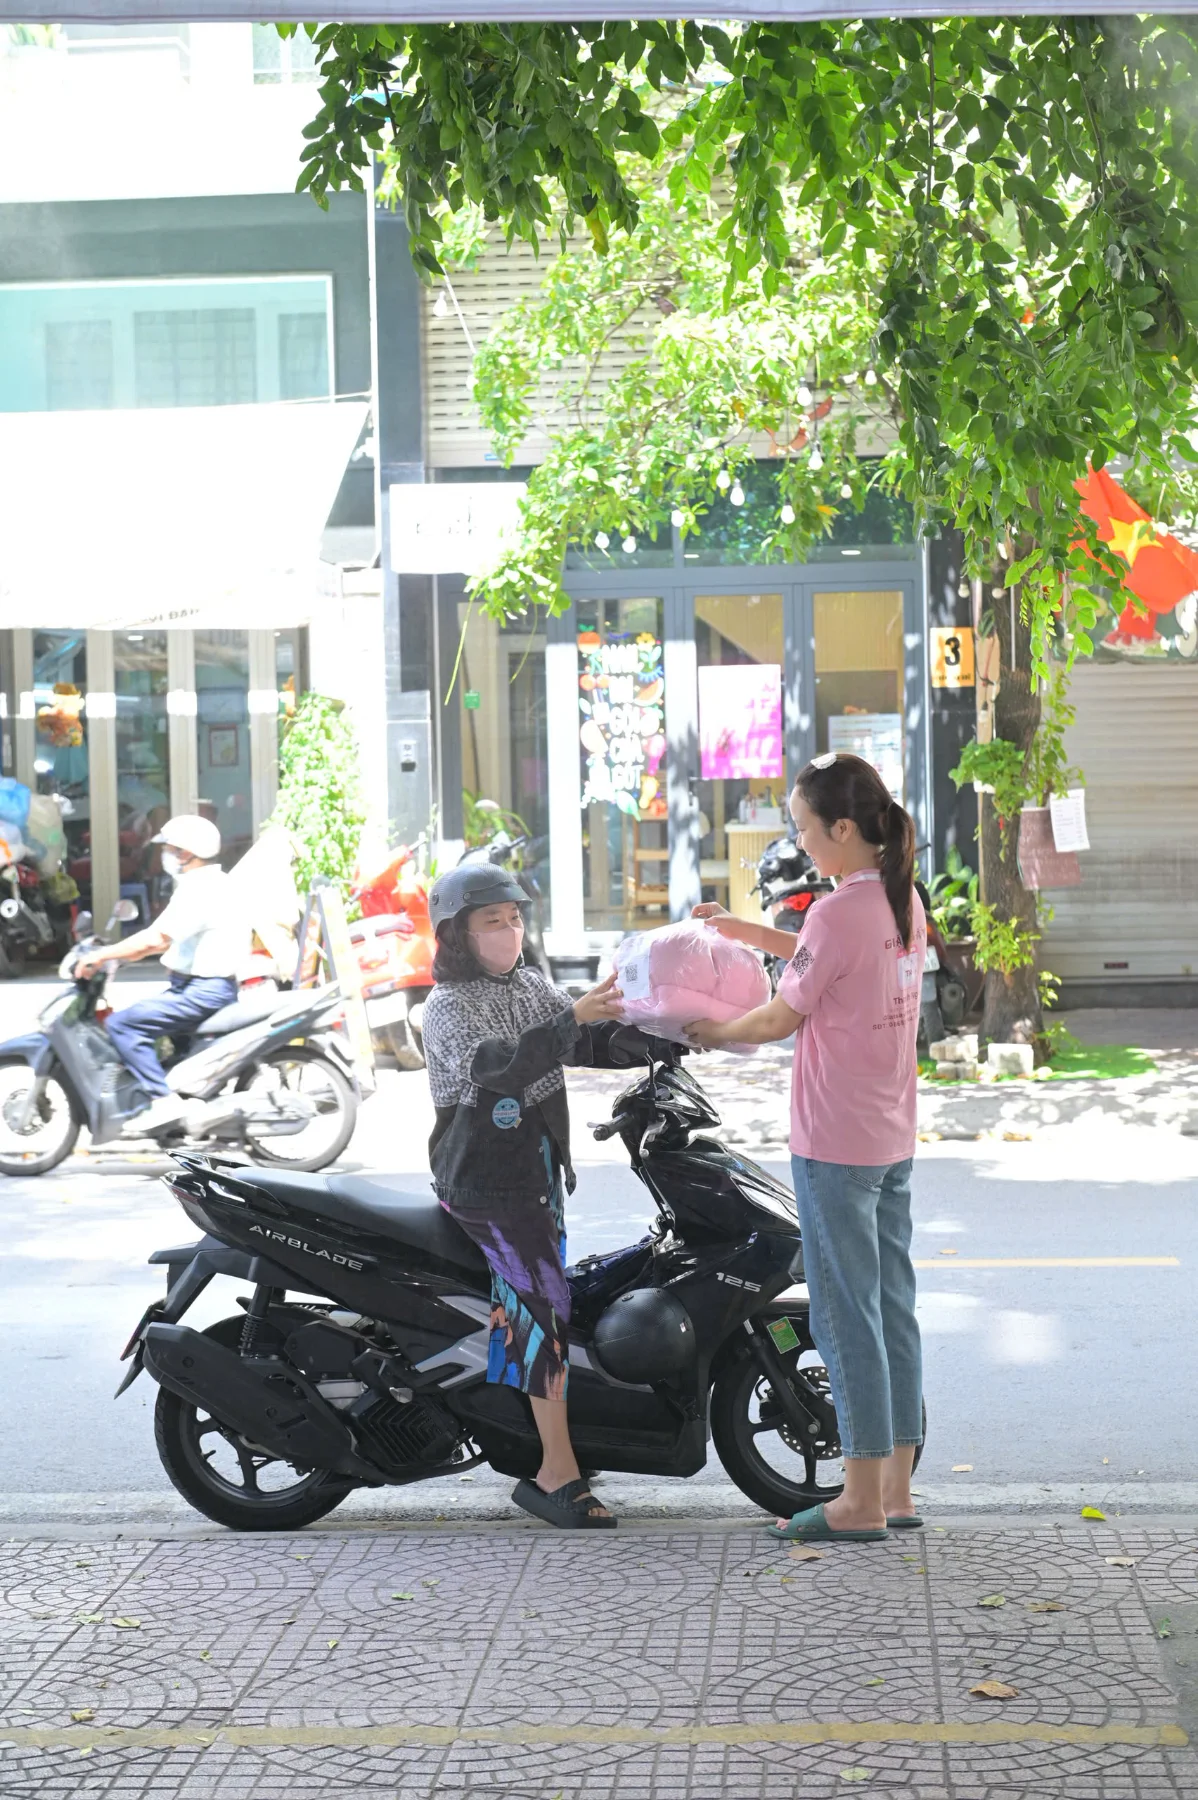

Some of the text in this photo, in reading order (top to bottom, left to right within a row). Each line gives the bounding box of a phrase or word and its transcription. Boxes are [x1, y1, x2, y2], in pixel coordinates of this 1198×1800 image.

[944, 637, 961, 666] 3
[249, 1225, 363, 1271] AIRBLADE
[716, 1272, 762, 1293] 125
